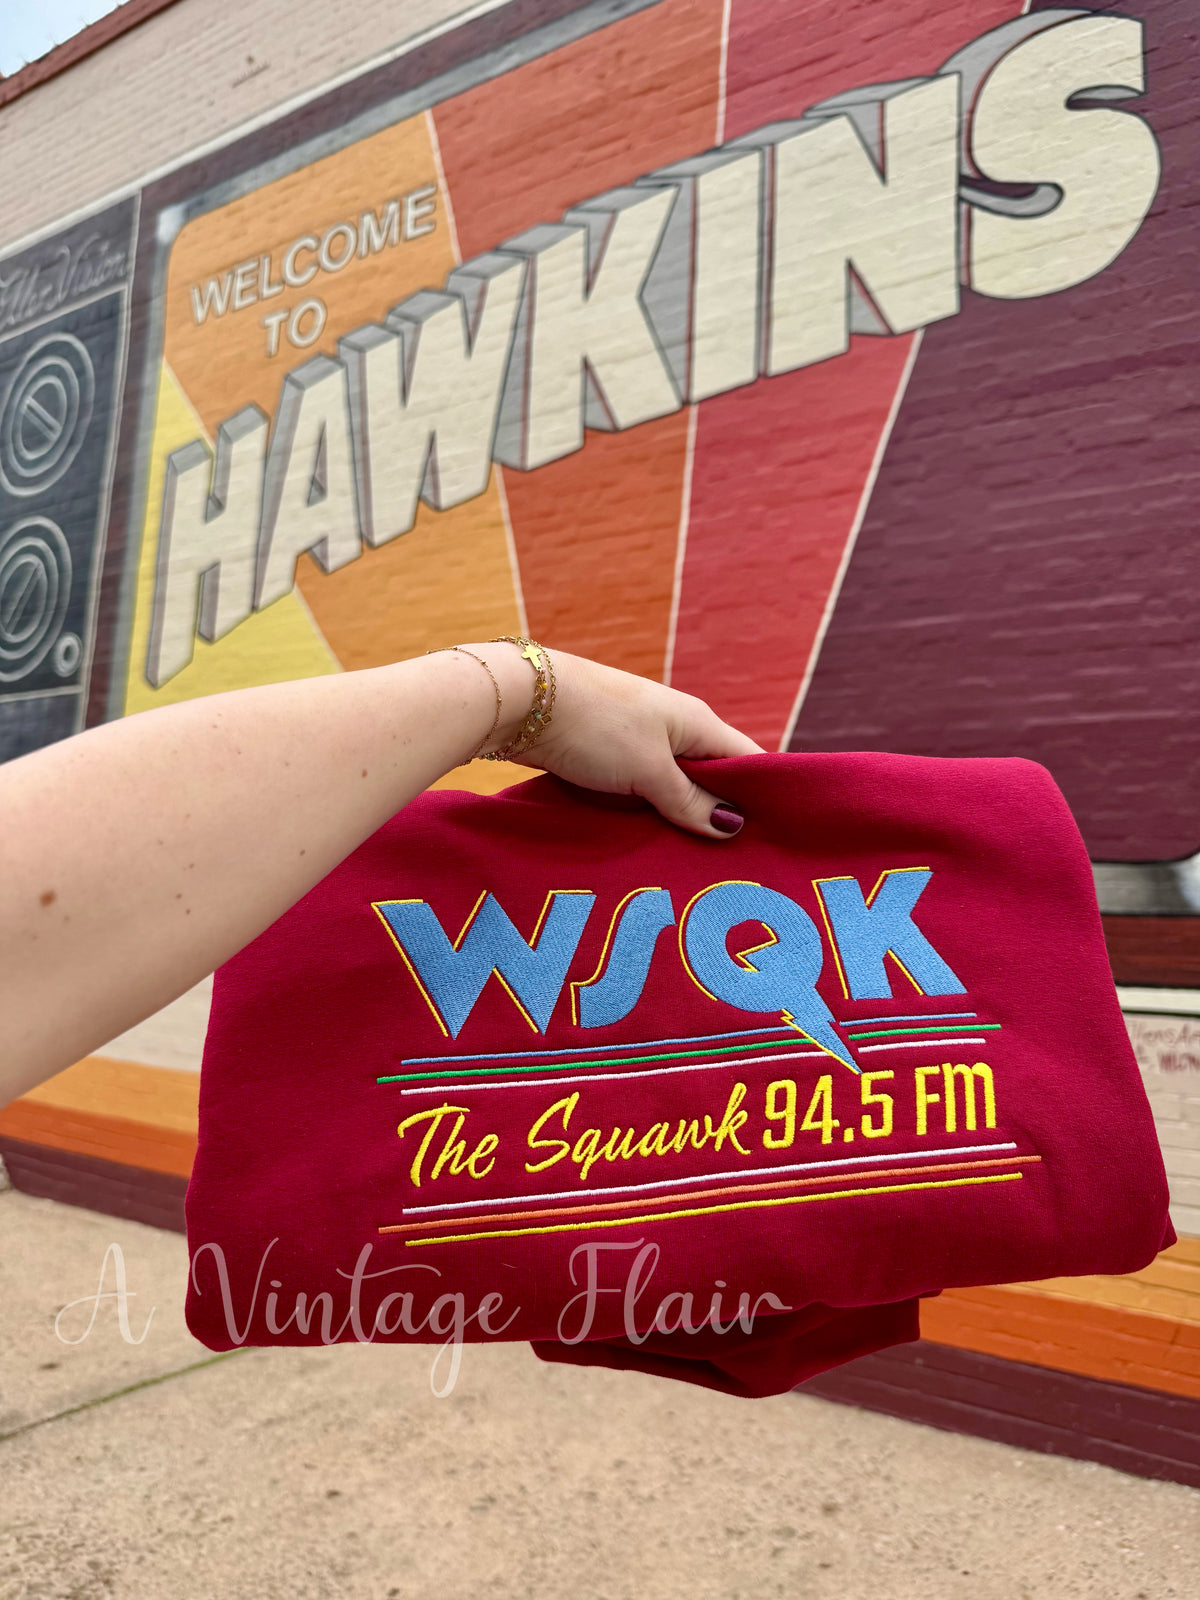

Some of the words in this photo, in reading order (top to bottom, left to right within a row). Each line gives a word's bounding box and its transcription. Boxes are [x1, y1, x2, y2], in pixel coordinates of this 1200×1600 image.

[190, 184, 437, 325] WELCOME
[145, 8, 1161, 690] HAWKINS
[262, 297, 328, 358] TO
[371, 866, 967, 1073] WSQK
[398, 1101, 499, 1187] The
[525, 1082, 752, 1180] Squawk
[762, 1070, 895, 1149] 94.5
[914, 1061, 997, 1135] FM
